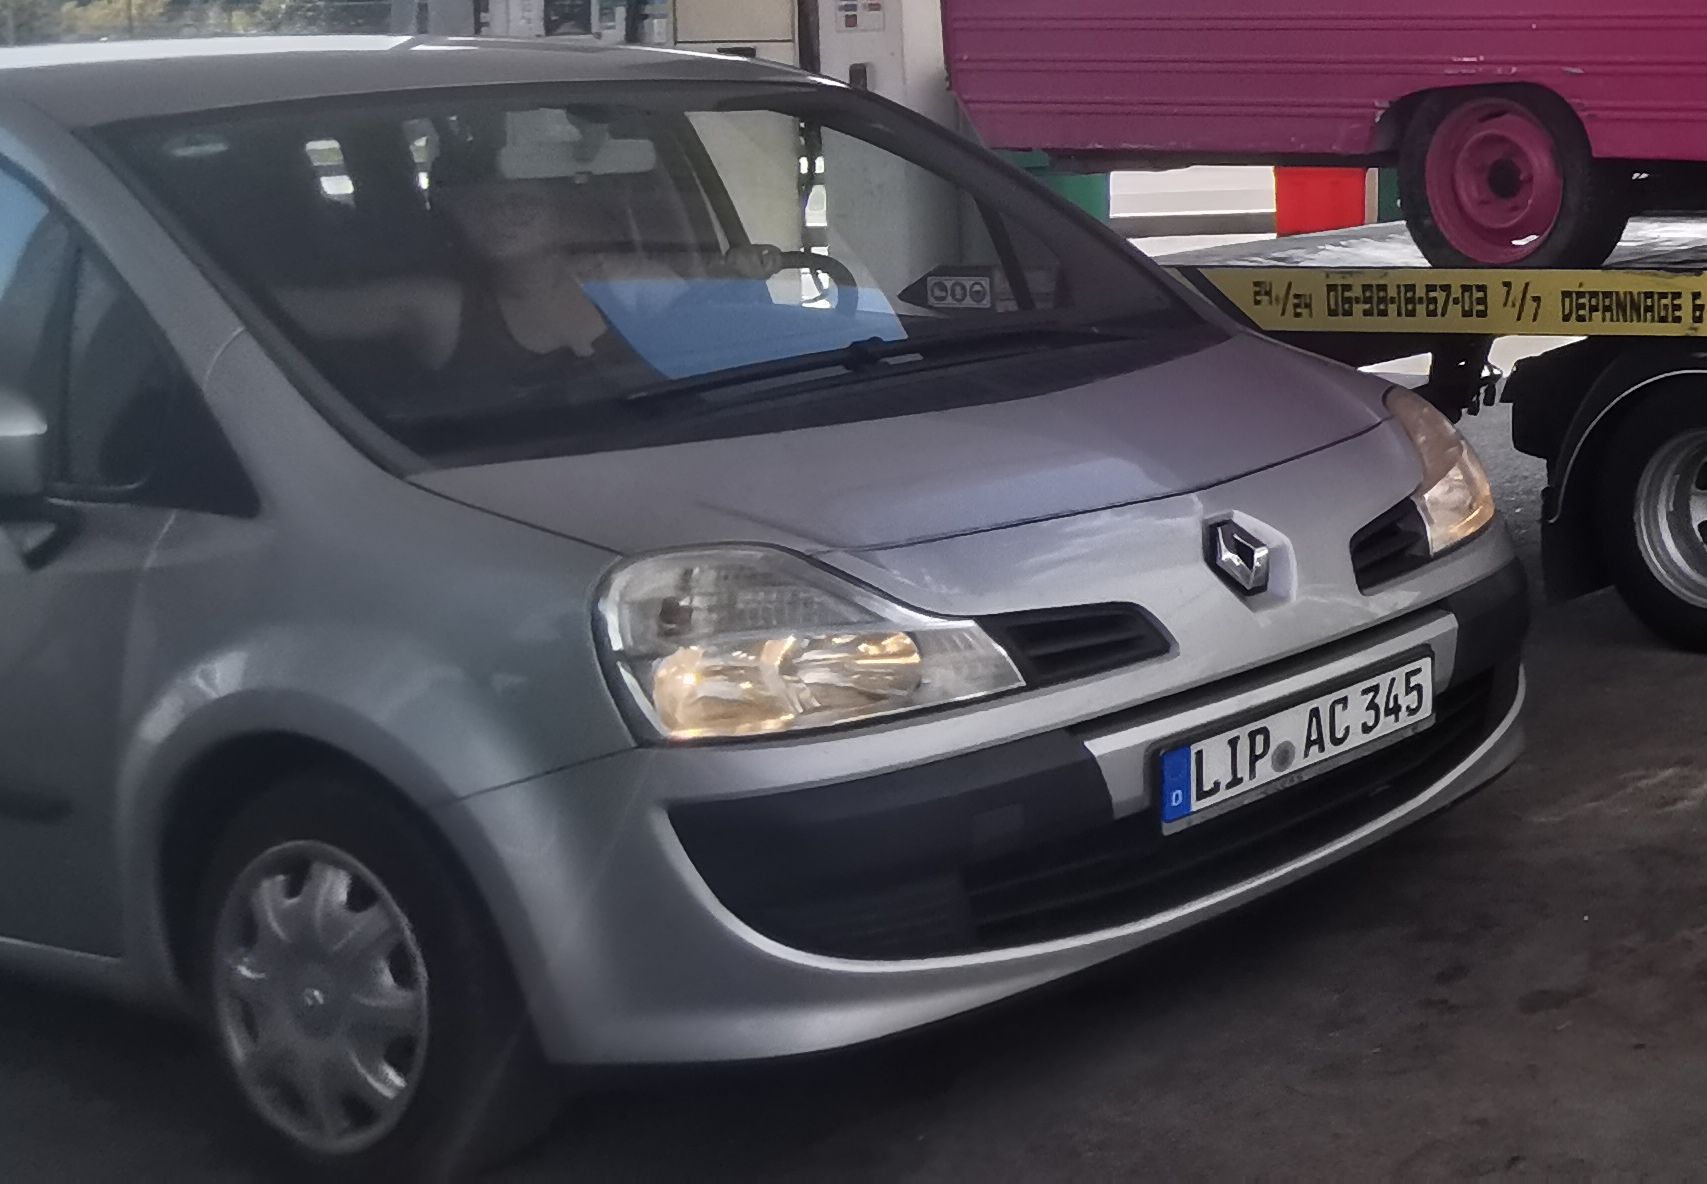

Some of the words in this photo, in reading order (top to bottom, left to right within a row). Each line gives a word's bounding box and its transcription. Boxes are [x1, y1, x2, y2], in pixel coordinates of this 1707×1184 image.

[1561, 282, 1683, 324] DÉPANNAGE
[1194, 725, 1271, 802] LIP
[1304, 694, 1350, 759] AC
[1360, 667, 1424, 735] 345
[1170, 789, 1183, 807] D
